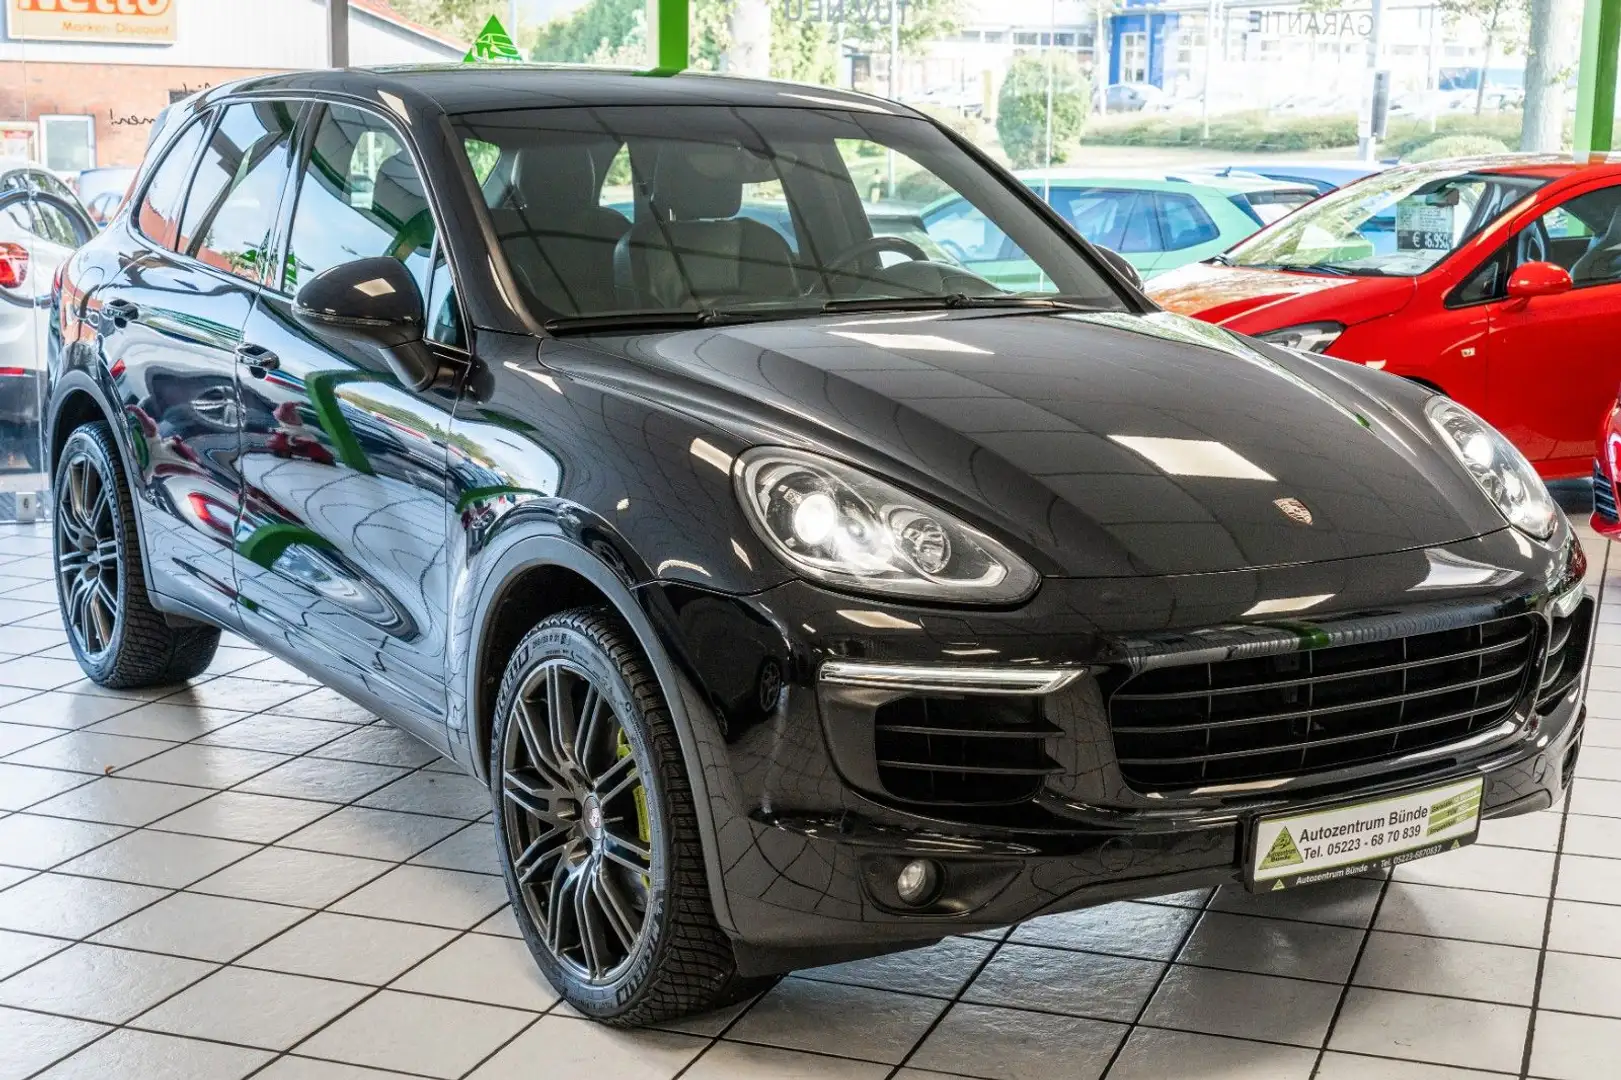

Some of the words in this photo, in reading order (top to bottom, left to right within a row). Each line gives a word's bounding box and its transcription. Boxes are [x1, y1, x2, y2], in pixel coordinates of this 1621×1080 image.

[1299, 817, 1385, 843] Autozentrum
[1389, 806, 1428, 826] Bünde
[1304, 845, 1323, 860] Tel.
[1327, 838, 1360, 856] 05223
[1371, 834, 1384, 847] 68
[1387, 830, 1400, 843] 70
[1402, 825, 1421, 839] 839
[1296, 869, 1344, 885] Autozentrum
[1345, 864, 1368, 876] Bünde
